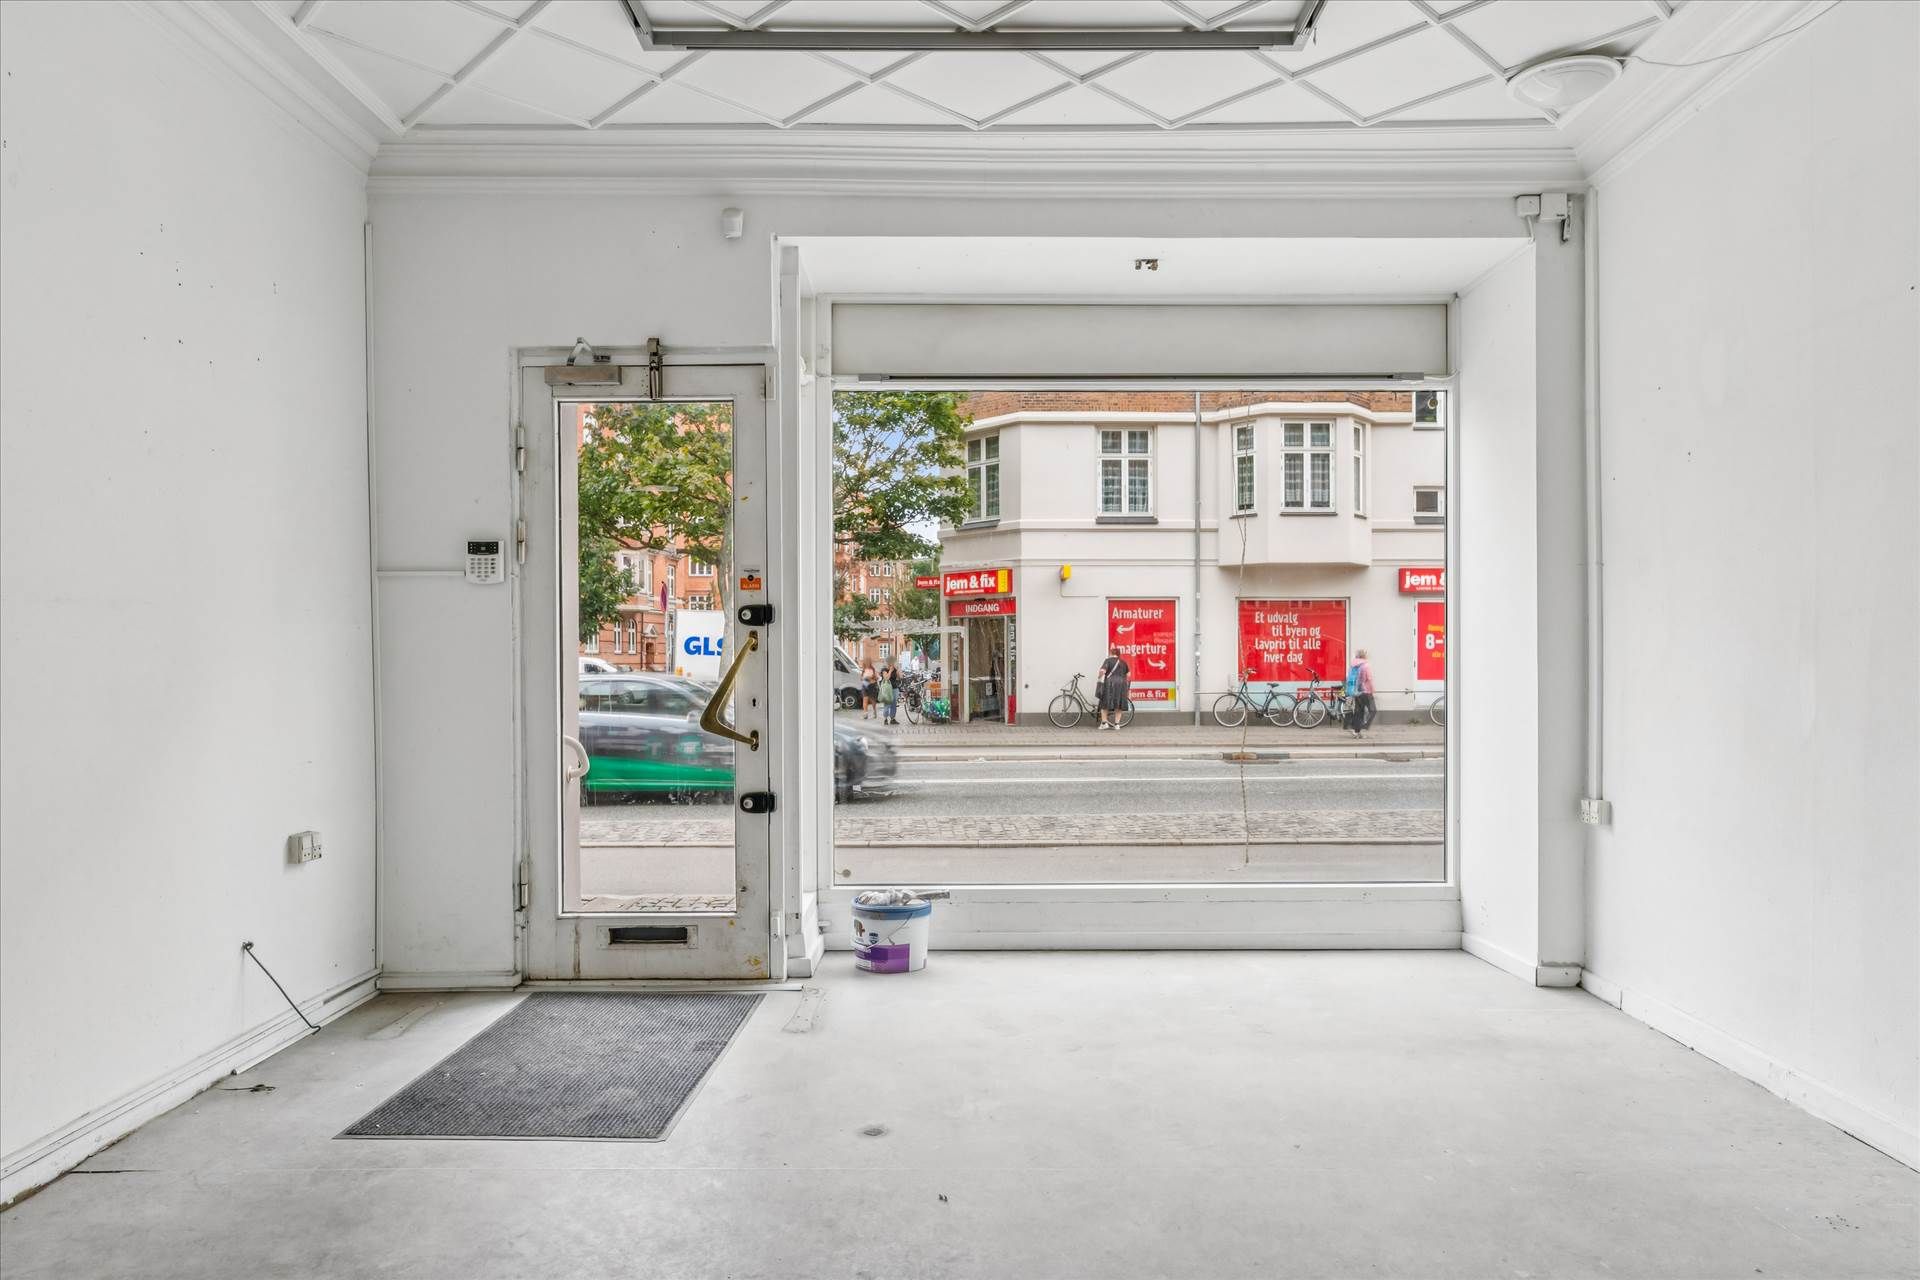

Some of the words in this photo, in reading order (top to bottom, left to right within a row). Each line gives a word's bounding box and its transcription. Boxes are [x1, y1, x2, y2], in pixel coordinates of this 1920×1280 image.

[946, 577, 968, 592] jem
[969, 575, 979, 588] &
[980, 574, 996, 588] fix
[1404, 571, 1437, 588] jem
[965, 603, 999, 612] INDGANG
[1112, 607, 1164, 620] Armaturer
[1255, 611, 1264, 624] Et
[1267, 611, 1298, 625] udvalg
[1272, 625, 1283, 637] til
[1285, 625, 1307, 638] byen
[1309, 627, 1321, 639] og
[1255, 638, 1286, 652] lavpris
[1289, 638, 1301, 650] til
[1303, 638, 1321, 650] alle
[1264, 651, 1284, 663] hver
[1287, 651, 1303, 664] dag
[1155, 690, 1166, 698] fix
